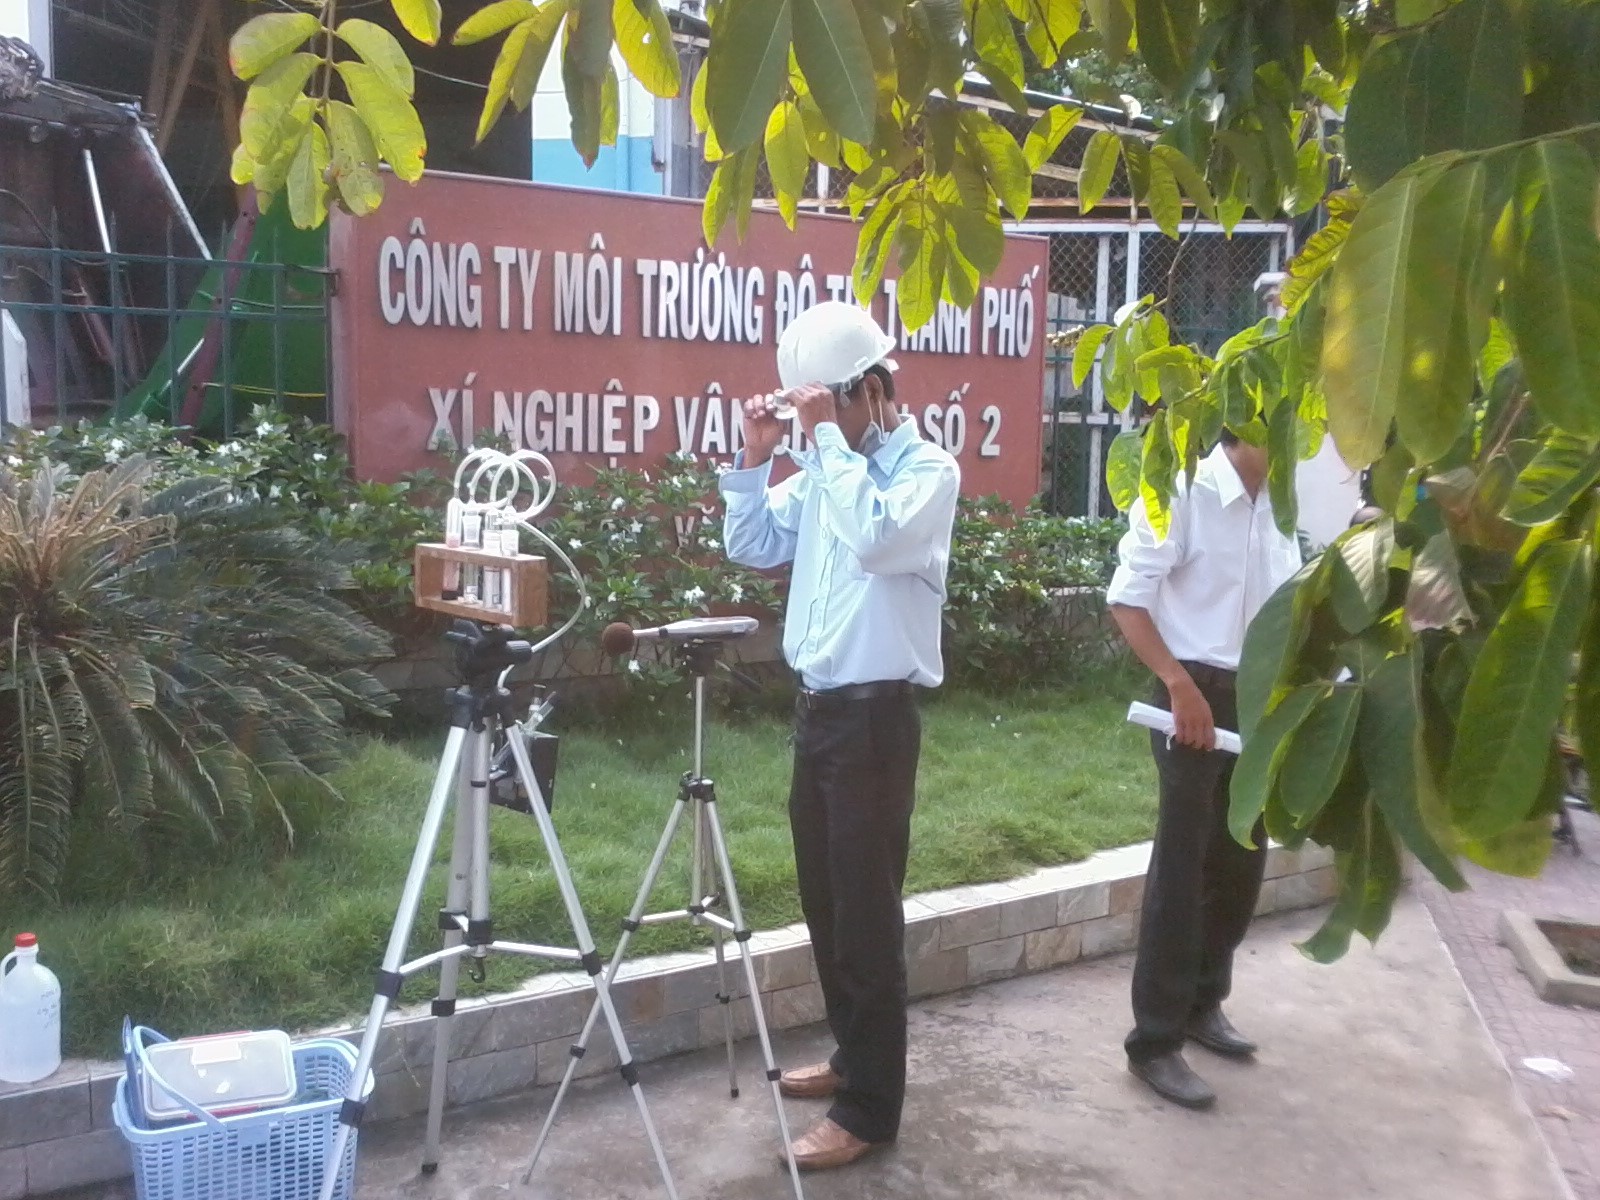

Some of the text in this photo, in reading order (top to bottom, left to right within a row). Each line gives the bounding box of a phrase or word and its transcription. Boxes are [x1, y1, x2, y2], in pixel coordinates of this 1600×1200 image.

[379, 217, 482, 329] CÔNG
[494, 246, 541, 330] TY
[554, 233, 622, 336] MÔI
[982, 265, 1039, 357] PHỐ
[427, 372, 477, 450] XÍ
[493, 378, 660, 468] NGHIỆP
[924, 383, 970, 457] SỐ
[981, 405, 1001, 456] 2
